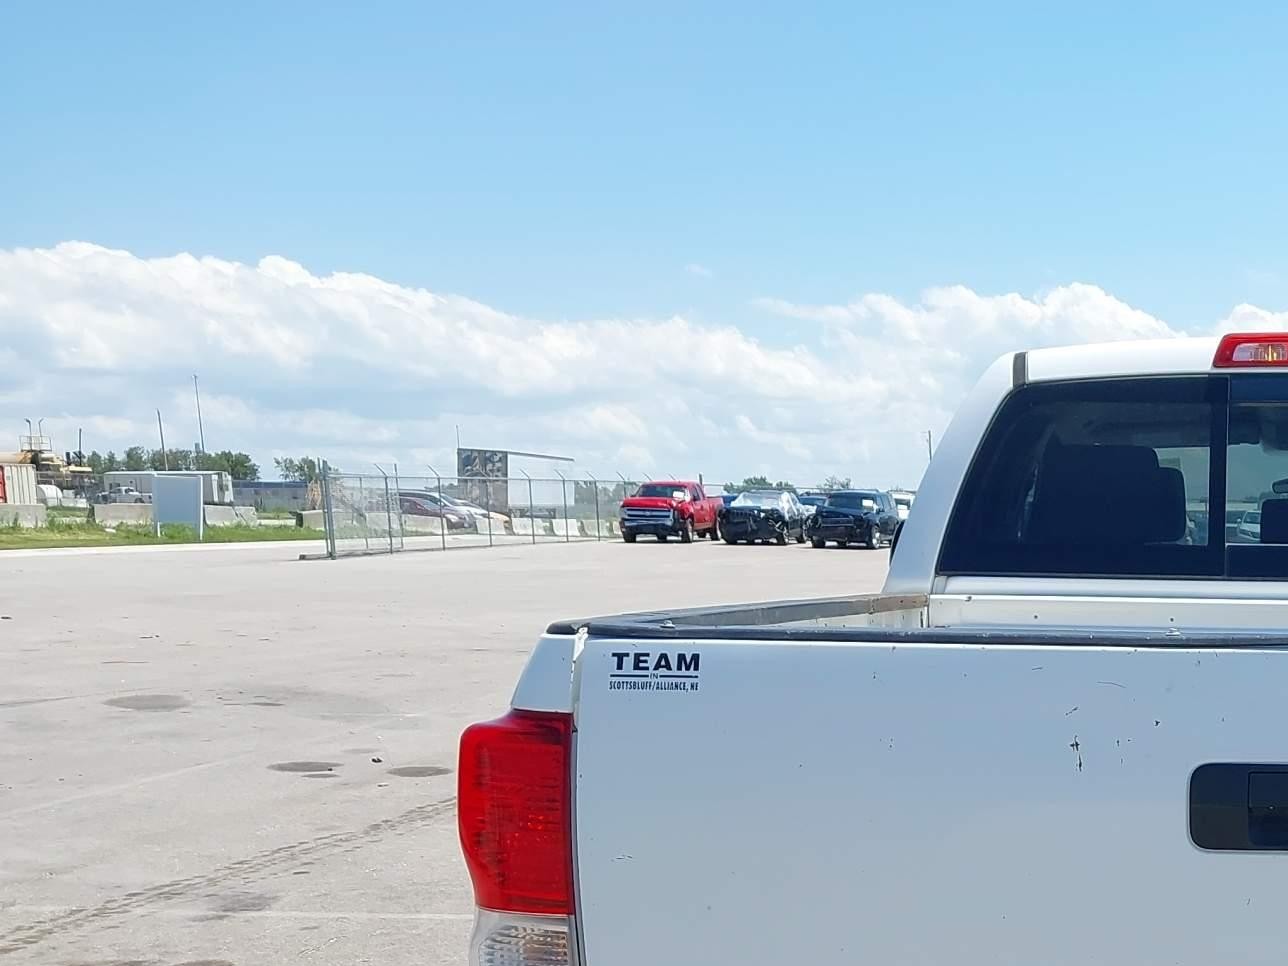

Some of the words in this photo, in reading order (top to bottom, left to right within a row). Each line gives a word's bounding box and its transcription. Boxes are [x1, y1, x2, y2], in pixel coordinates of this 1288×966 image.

[611, 652, 700, 672] TEAM
[649, 672, 659, 680] IN
[690, 681, 699, 691] NE
